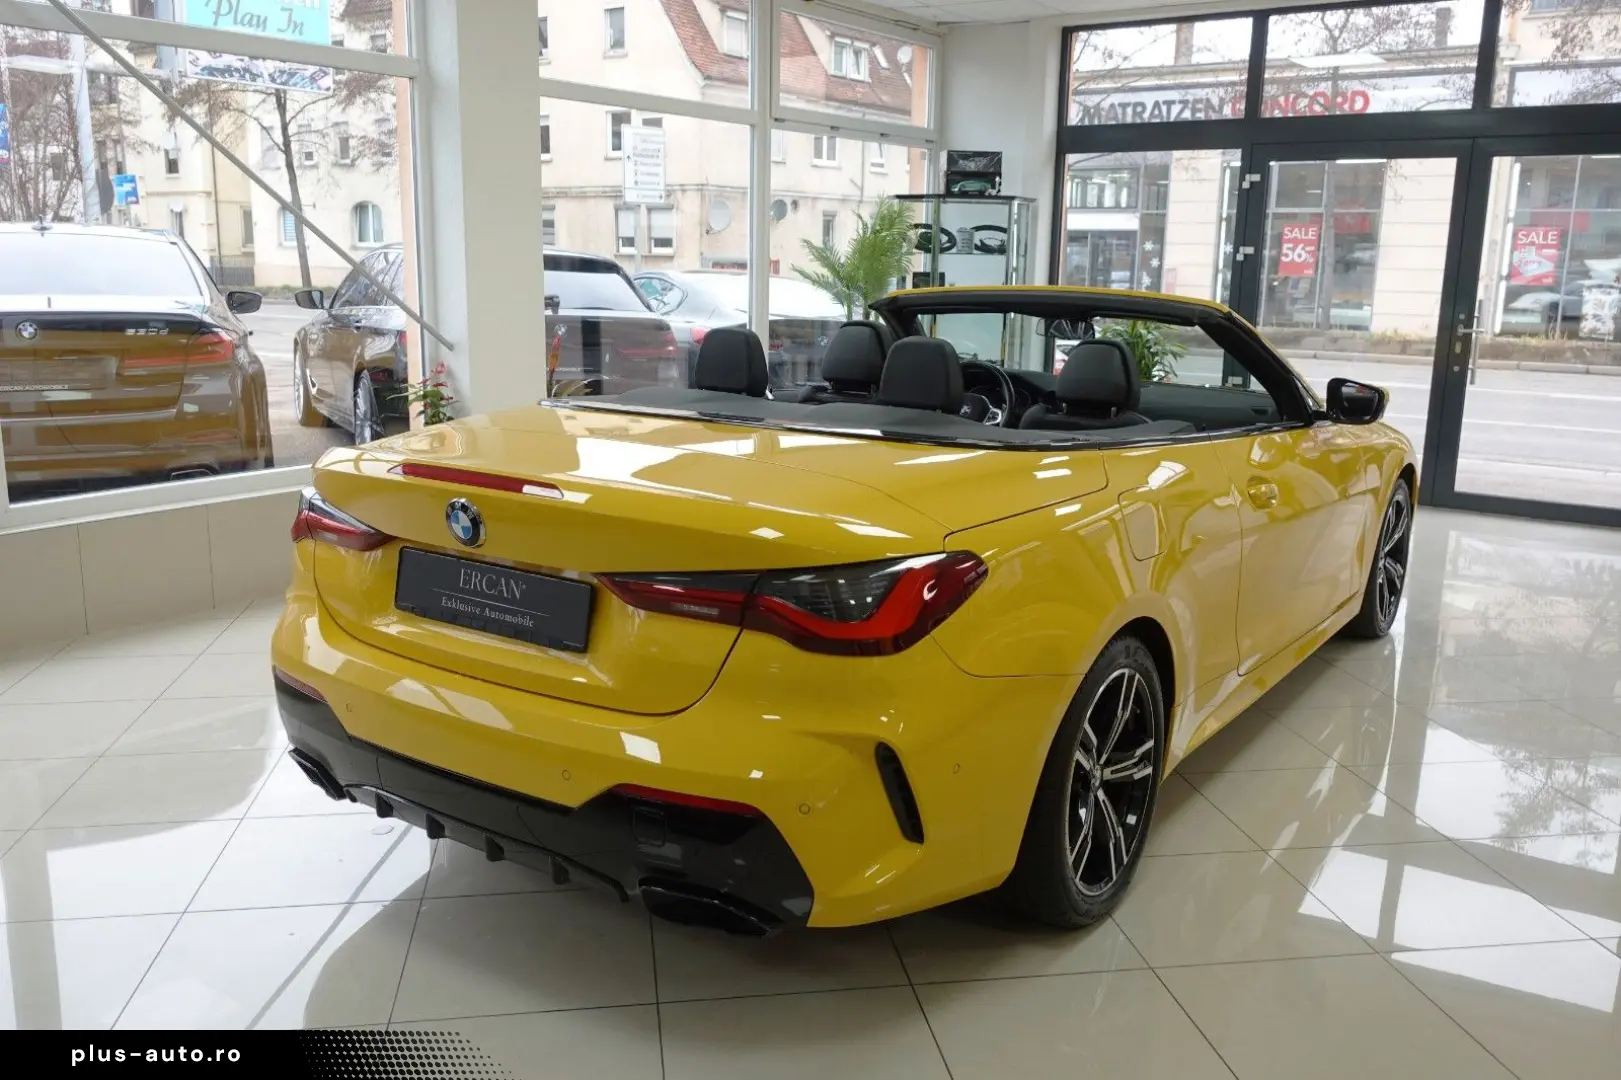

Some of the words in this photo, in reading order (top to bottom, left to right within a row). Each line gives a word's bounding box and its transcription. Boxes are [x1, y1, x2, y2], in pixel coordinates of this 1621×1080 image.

[205, 0, 267, 32] Play
[277, 6, 304, 36] In
[1079, 97, 1226, 125] MATRATZEN
[1230, 90, 1370, 118] CNCORD
[1283, 227, 1317, 240] SALE
[1517, 231, 1558, 244] SALE
[441, 596, 481, 615] Exklusive
[483, 607, 535, 628] Automobile
